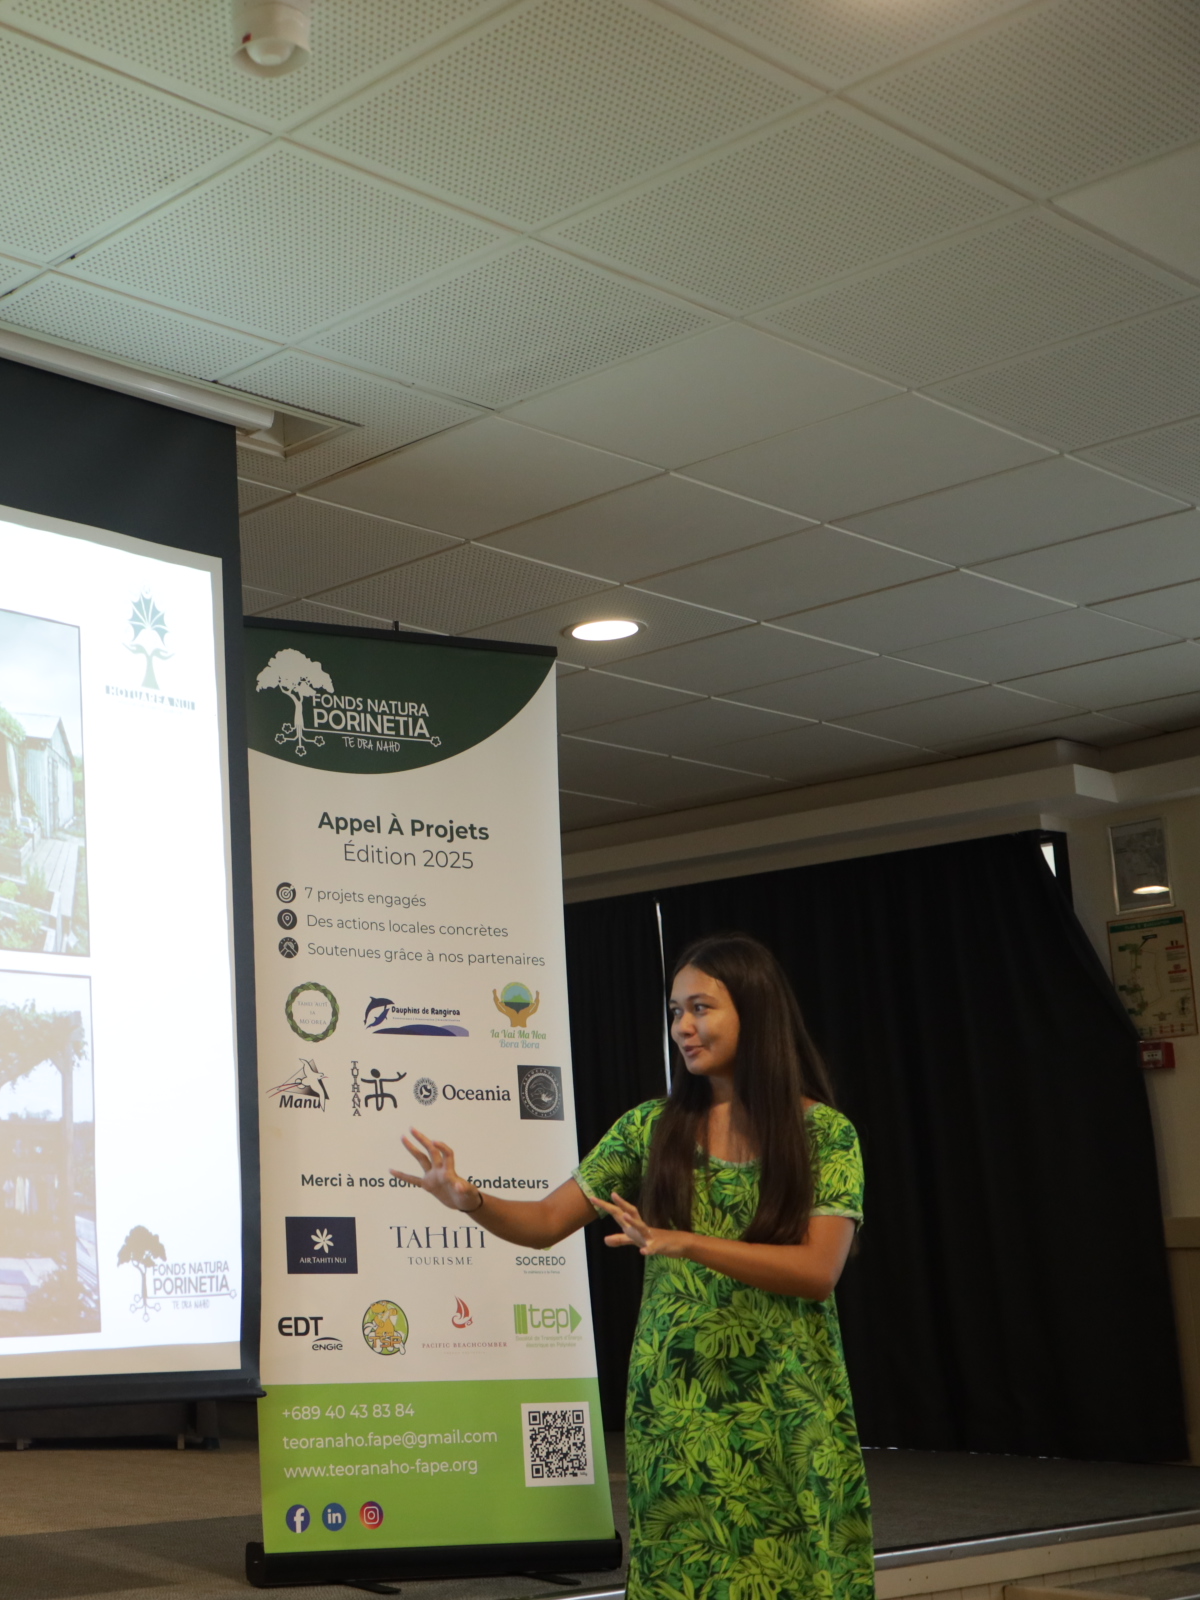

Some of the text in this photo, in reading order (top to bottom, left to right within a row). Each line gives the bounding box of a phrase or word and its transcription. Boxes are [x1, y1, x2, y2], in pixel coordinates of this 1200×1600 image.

[312, 694, 429, 717] FONDS NATURA
[313, 708, 430, 738] PORINETIA
[342, 736, 400, 752] TE ORA NAHO
[318, 812, 489, 843] Appel À Projets
[344, 840, 473, 869] Édition 2025
[304, 887, 426, 908] 7 projets engagés
[307, 914, 509, 937] Des actions locales concrètes
[307, 943, 545, 967] Soutenues grâce à nos partenaires
[391, 1006, 420, 1015] Dauphins
[431, 1007, 461, 1017] Rangiroa
[501, 1029, 515, 1038] Vai
[517, 1029, 530, 1039] Ma
[531, 1030, 546, 1039] Noa
[499, 1039, 540, 1049] Bora Bora
[279, 1095, 321, 1109] Manu
[442, 1085, 511, 1101] Oceania
[301, 1174, 342, 1187] Merci
[346, 1174, 354, 1187] à
[359, 1177, 385, 1188] nos
[467, 1176, 549, 1189] fondateurs
[152, 1260, 229, 1276] FONDS NATURA
[408, 1257, 473, 1265] TOURISME
[515, 1256, 566, 1266] SOCREDO
[153, 1274, 229, 1295] PORINETIA
[278, 1316, 323, 1336] EDT
[528, 1304, 569, 1334] tep
[369, 1336, 401, 1348] TSP
[282, 1403, 415, 1420] +689 40 43 83 84
[283, 1429, 498, 1449] teoranaho.fape@gmail.com
[284, 1459, 478, 1478] www.teoranaho-fape.org
